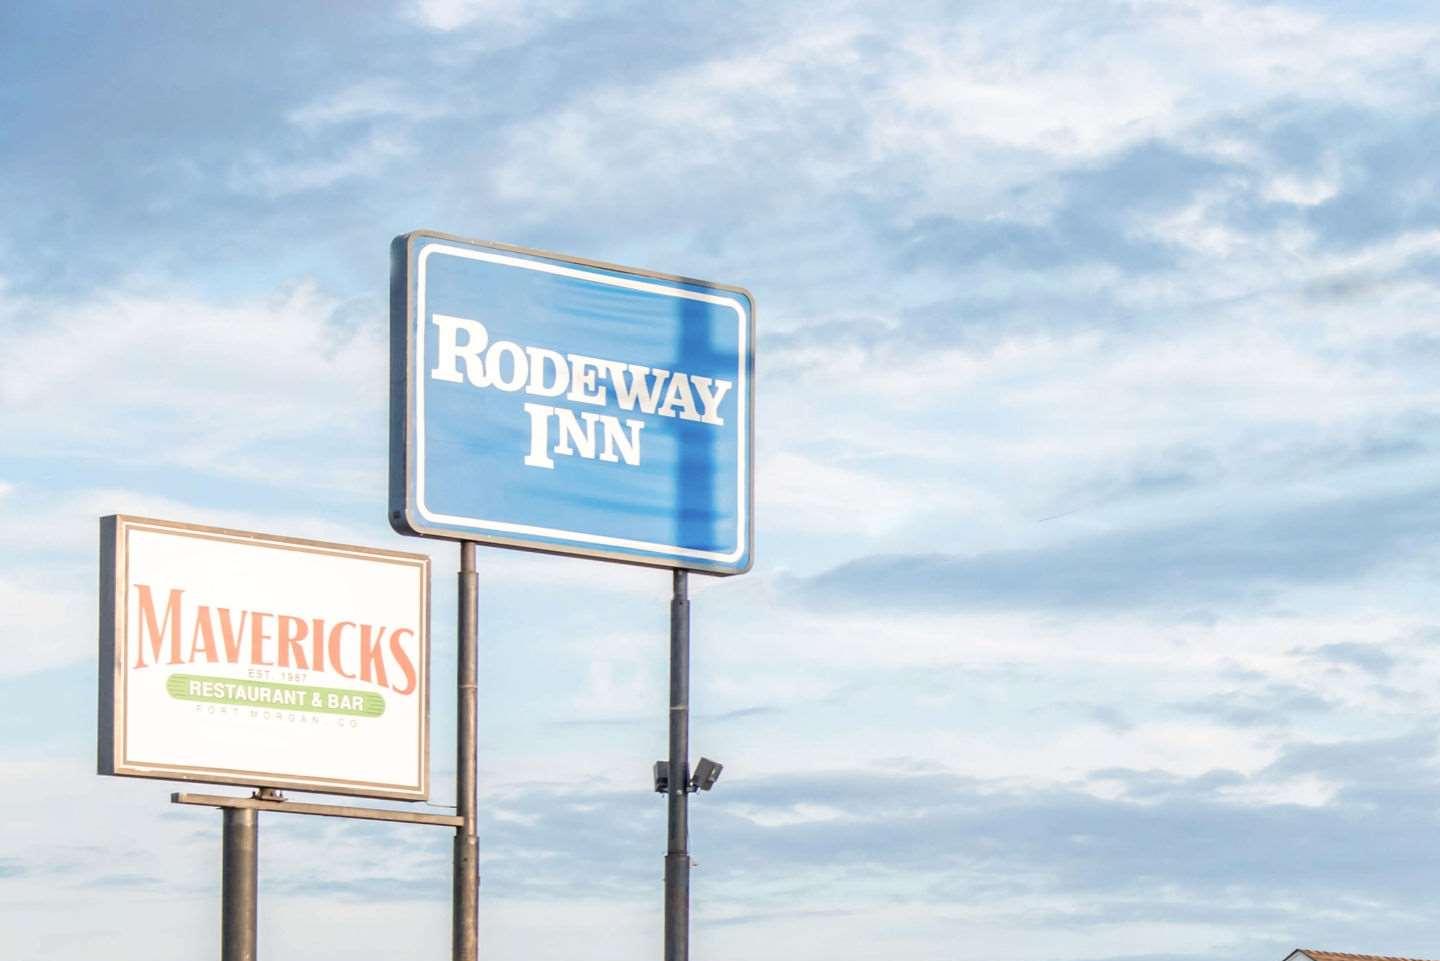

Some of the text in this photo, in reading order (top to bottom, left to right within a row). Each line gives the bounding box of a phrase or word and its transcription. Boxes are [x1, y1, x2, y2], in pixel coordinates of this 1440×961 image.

[431, 314, 732, 426] RODEWAY
[524, 402, 644, 469] INN
[133, 583, 417, 696] MAVERICKS
[189, 680, 364, 711] RESTAURANT & BAR
